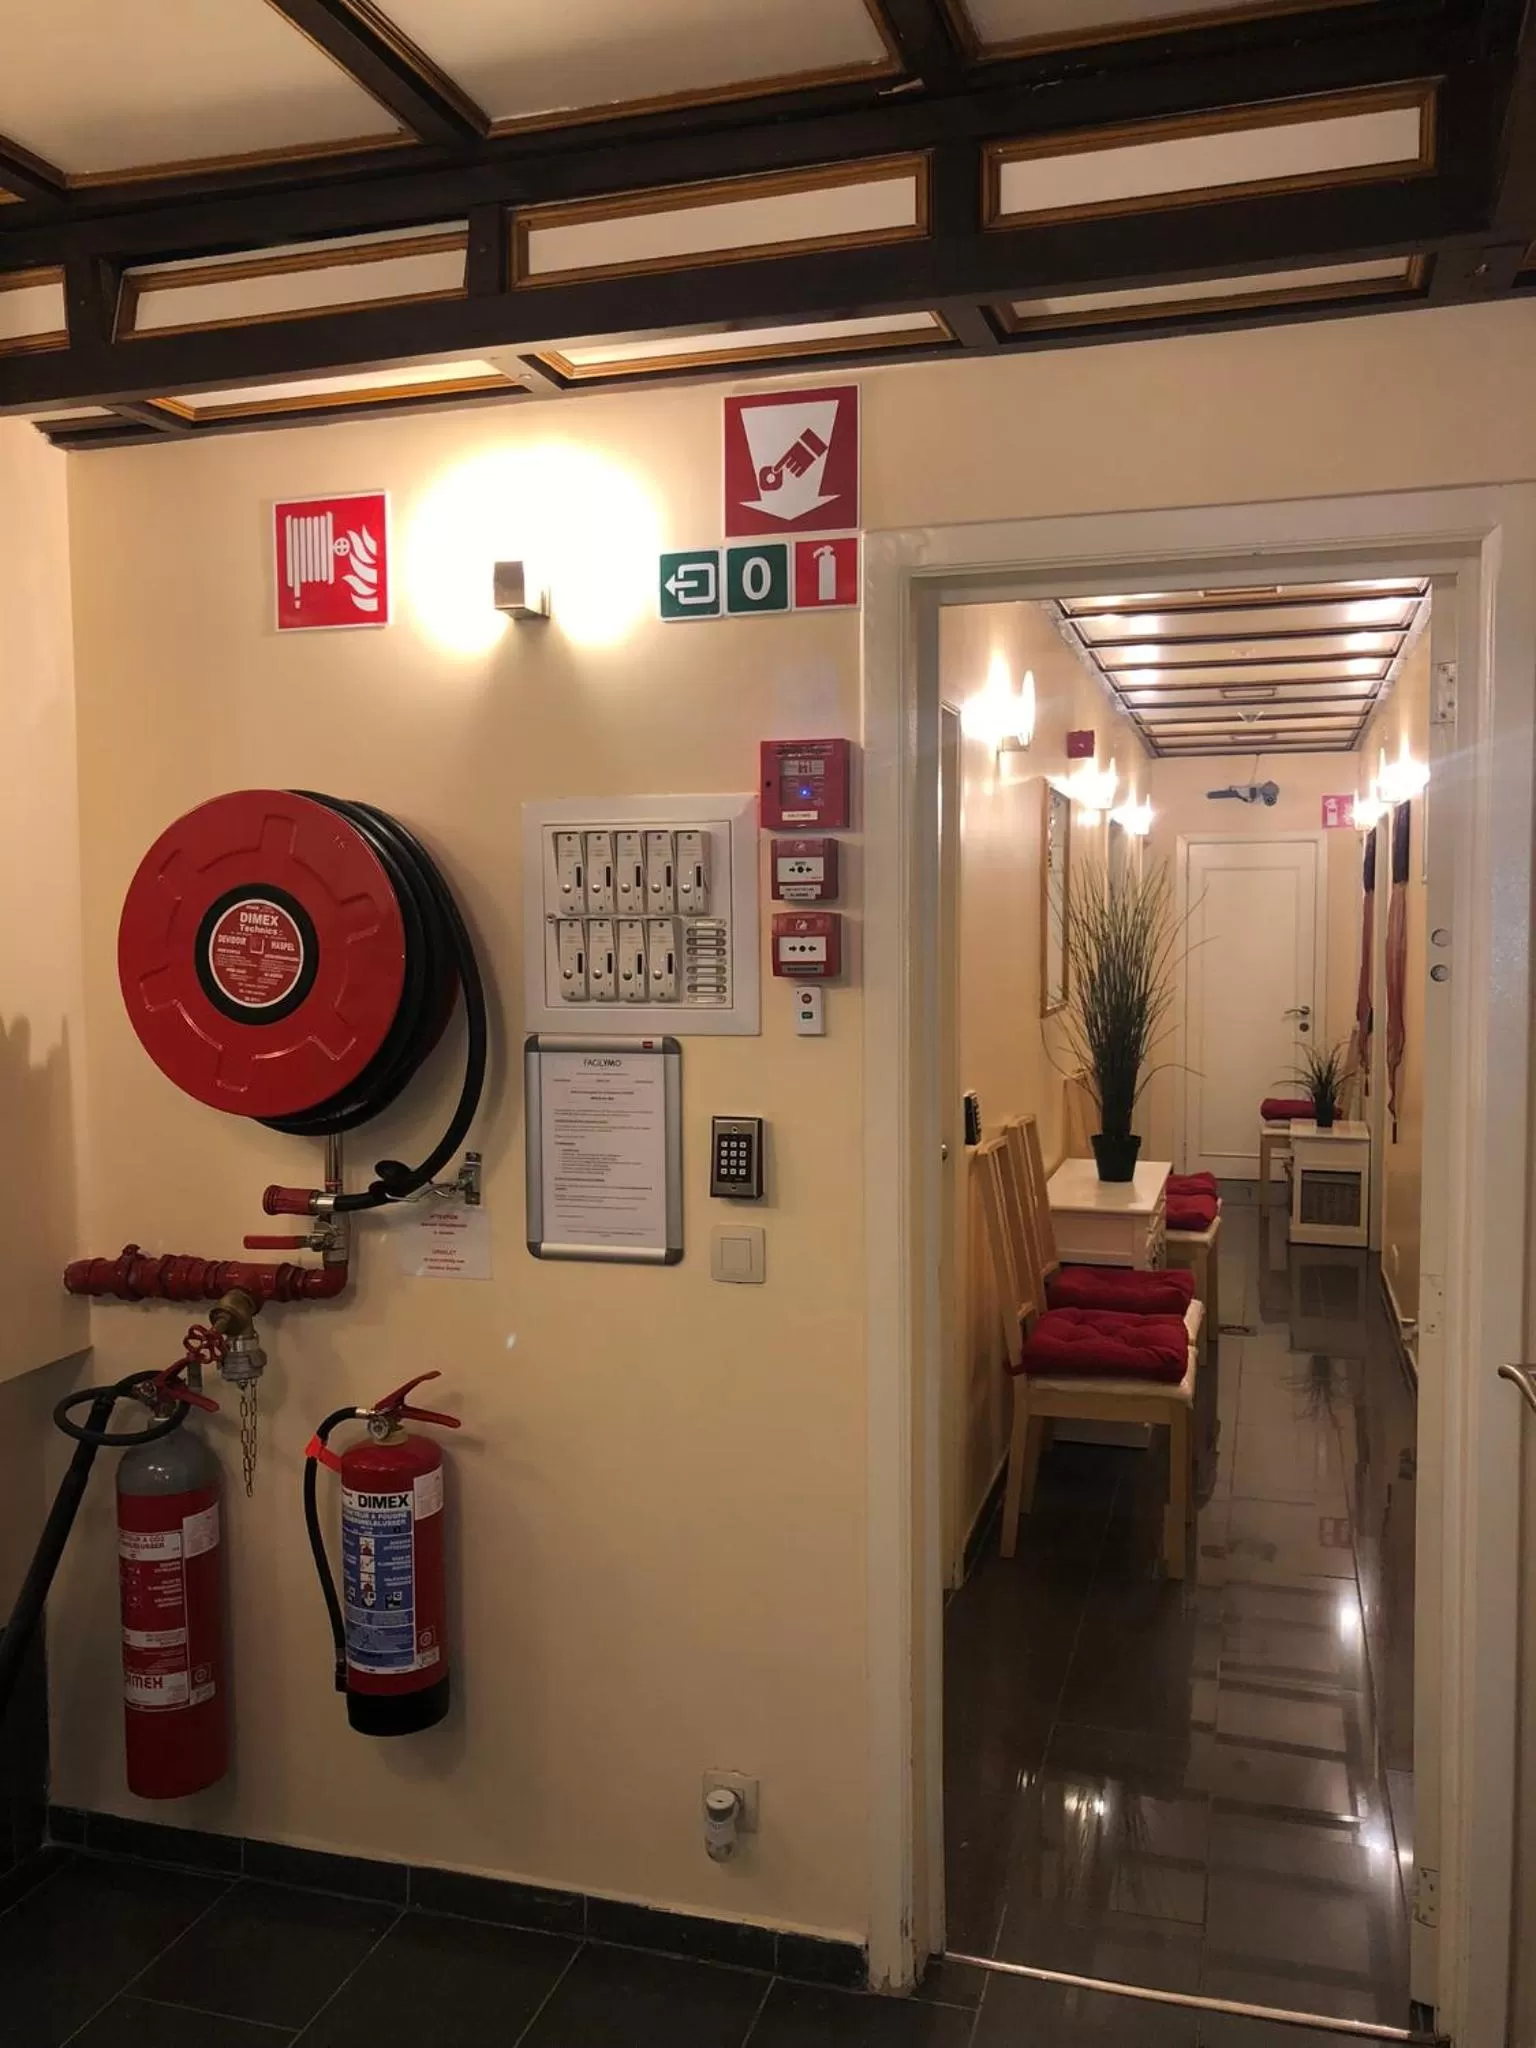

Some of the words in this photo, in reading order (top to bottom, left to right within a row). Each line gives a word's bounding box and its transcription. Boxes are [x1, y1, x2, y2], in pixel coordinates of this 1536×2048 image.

[742, 556, 772, 601] 0
[239, 911, 279, 927] DIMEX
[239, 924, 278, 936] Technics
[358, 1494, 409, 1509] DIMEX
